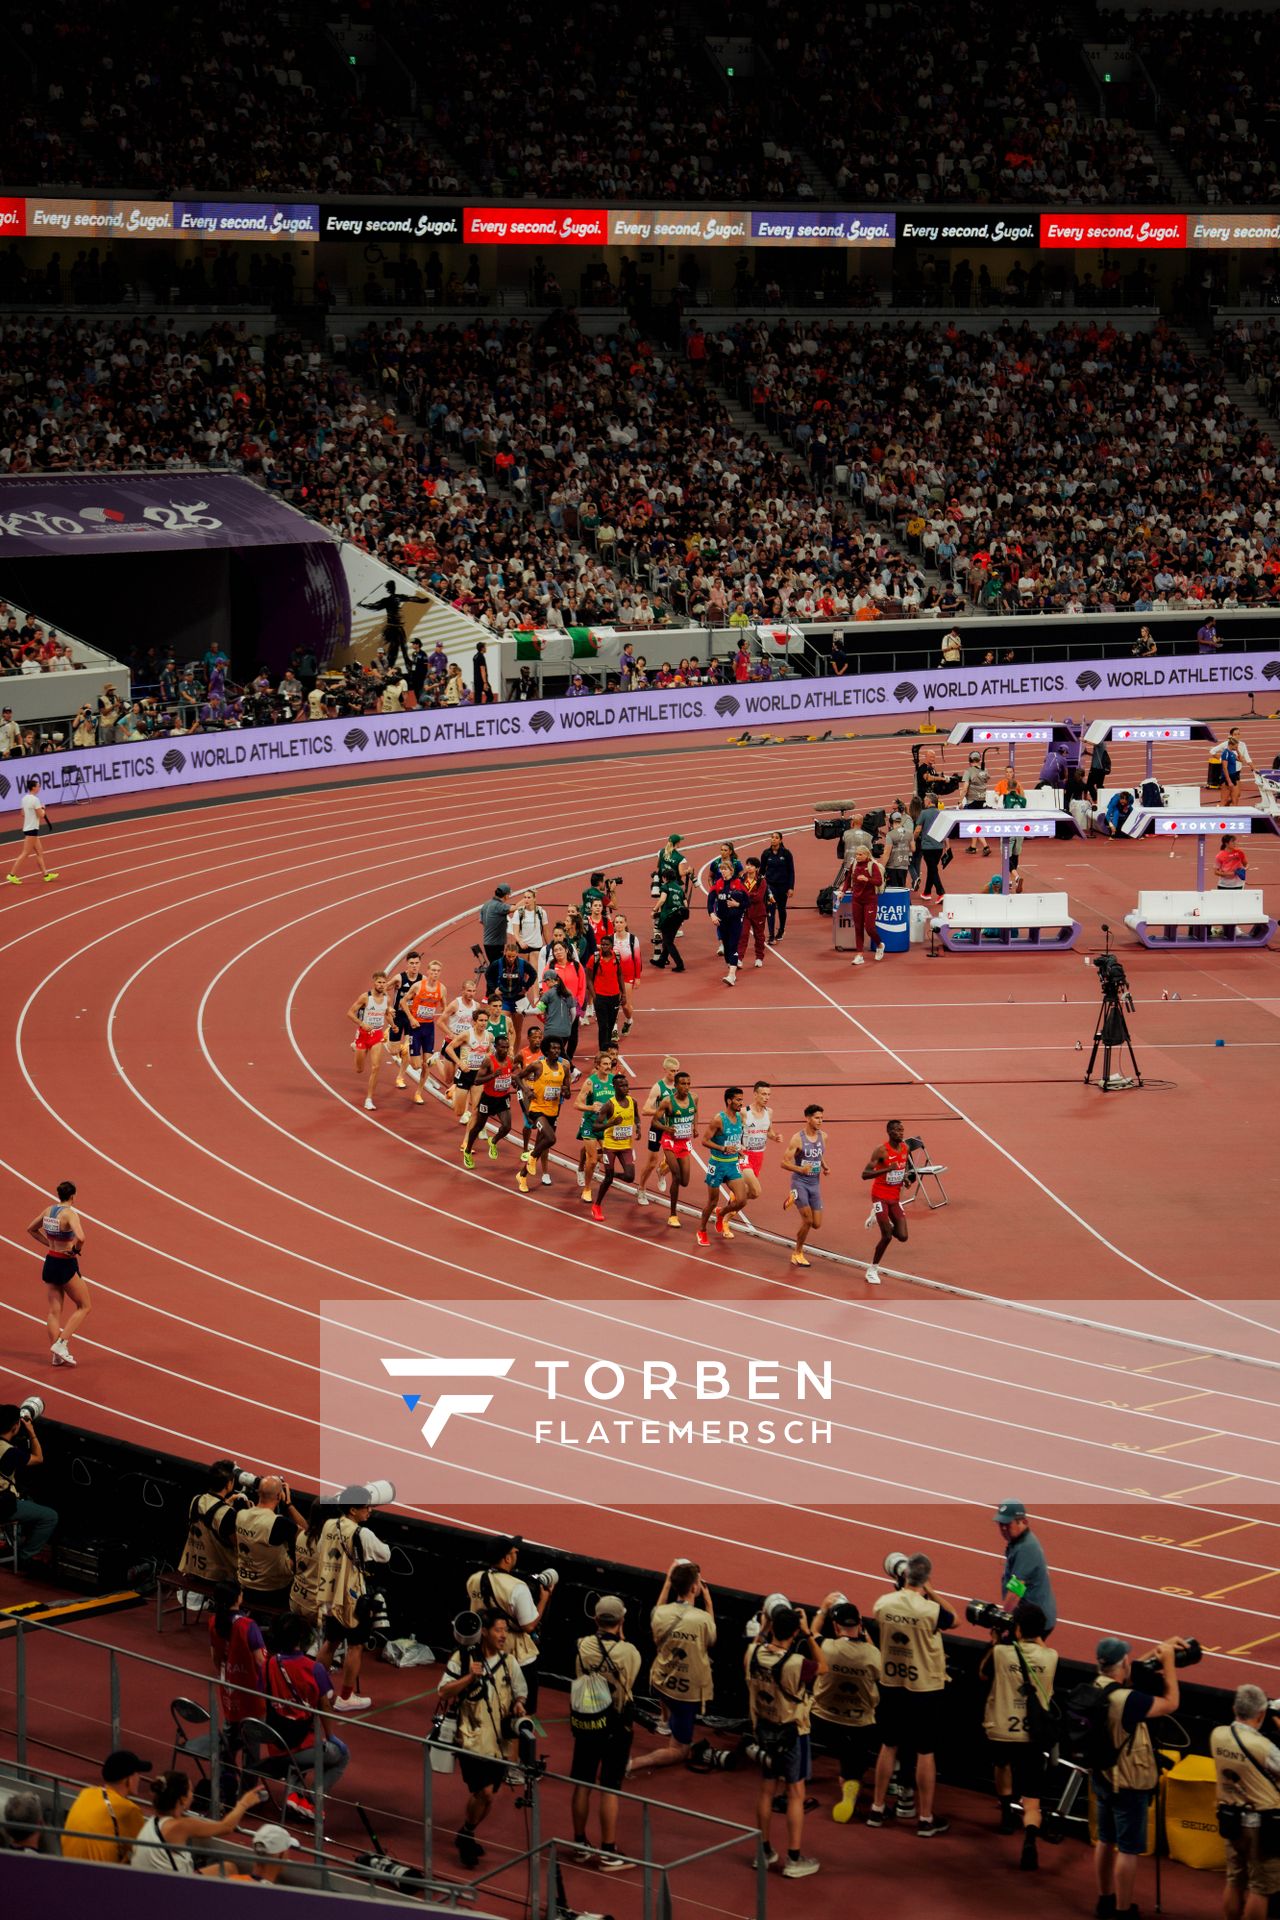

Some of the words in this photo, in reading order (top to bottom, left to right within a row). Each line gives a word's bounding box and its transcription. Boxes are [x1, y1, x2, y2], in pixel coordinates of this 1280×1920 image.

[33, 211, 70, 228] Every
[74, 212, 124, 228] second,
[127, 209, 171, 230] Sugoi.
[181, 213, 218, 230] Every
[221, 215, 268, 230] second,
[270, 213, 313, 234] Sugoi.
[327, 217, 362, 234] Every
[366, 218, 412, 234] second,
[415, 215, 457, 236] Sugoi.
[471, 219, 507, 235] Every
[510, 220, 559, 236] second,
[560, 217, 601, 238] Sugoi.
[615, 221, 651, 238] Every
[654, 222, 701, 237] second,
[704, 219, 745, 239] Sugoi.
[759, 223, 794, 239] Every
[796, 224, 845, 239] second,
[847, 220, 889, 241] Sugoi.
[903, 224, 938, 240] Every
[941, 225, 989, 239] second,
[992, 222, 1034, 241] Sugoi.
[1048, 225, 1084, 240] Every
[1086, 225, 1134, 240] second,
[1137, 222, 1180, 241] Sugoi.
[1194, 225, 1230, 240] Every
[1107, 670, 1165, 687] WORLD
[1168, 665, 1254, 684] ATHLETICS
[923, 682, 978, 699] WORLD
[980, 675, 1065, 695] ATHLETICS
[745, 694, 801, 713] WORLD
[804, 687, 886, 708] ATHLETICS
[560, 708, 615, 728] WORLD
[618, 701, 703, 723] ATHLETICS
[374, 725, 431, 747] WORLD
[434, 717, 520, 741] ATHLETICS
[191, 746, 247, 768] WORLD
[250, 736, 333, 761] ATHLETICS
[1033, 824, 1049, 832] 25
[1229, 822, 1245, 830] 25
[876, 913, 903, 921] WEAT
[805, 1147, 824, 1158] USA
[237, 1527, 257, 1538] ONY
[186, 1551, 207, 1571] 115
[885, 1613, 919, 1626] SONY
[832, 1664, 868, 1676] SONY
